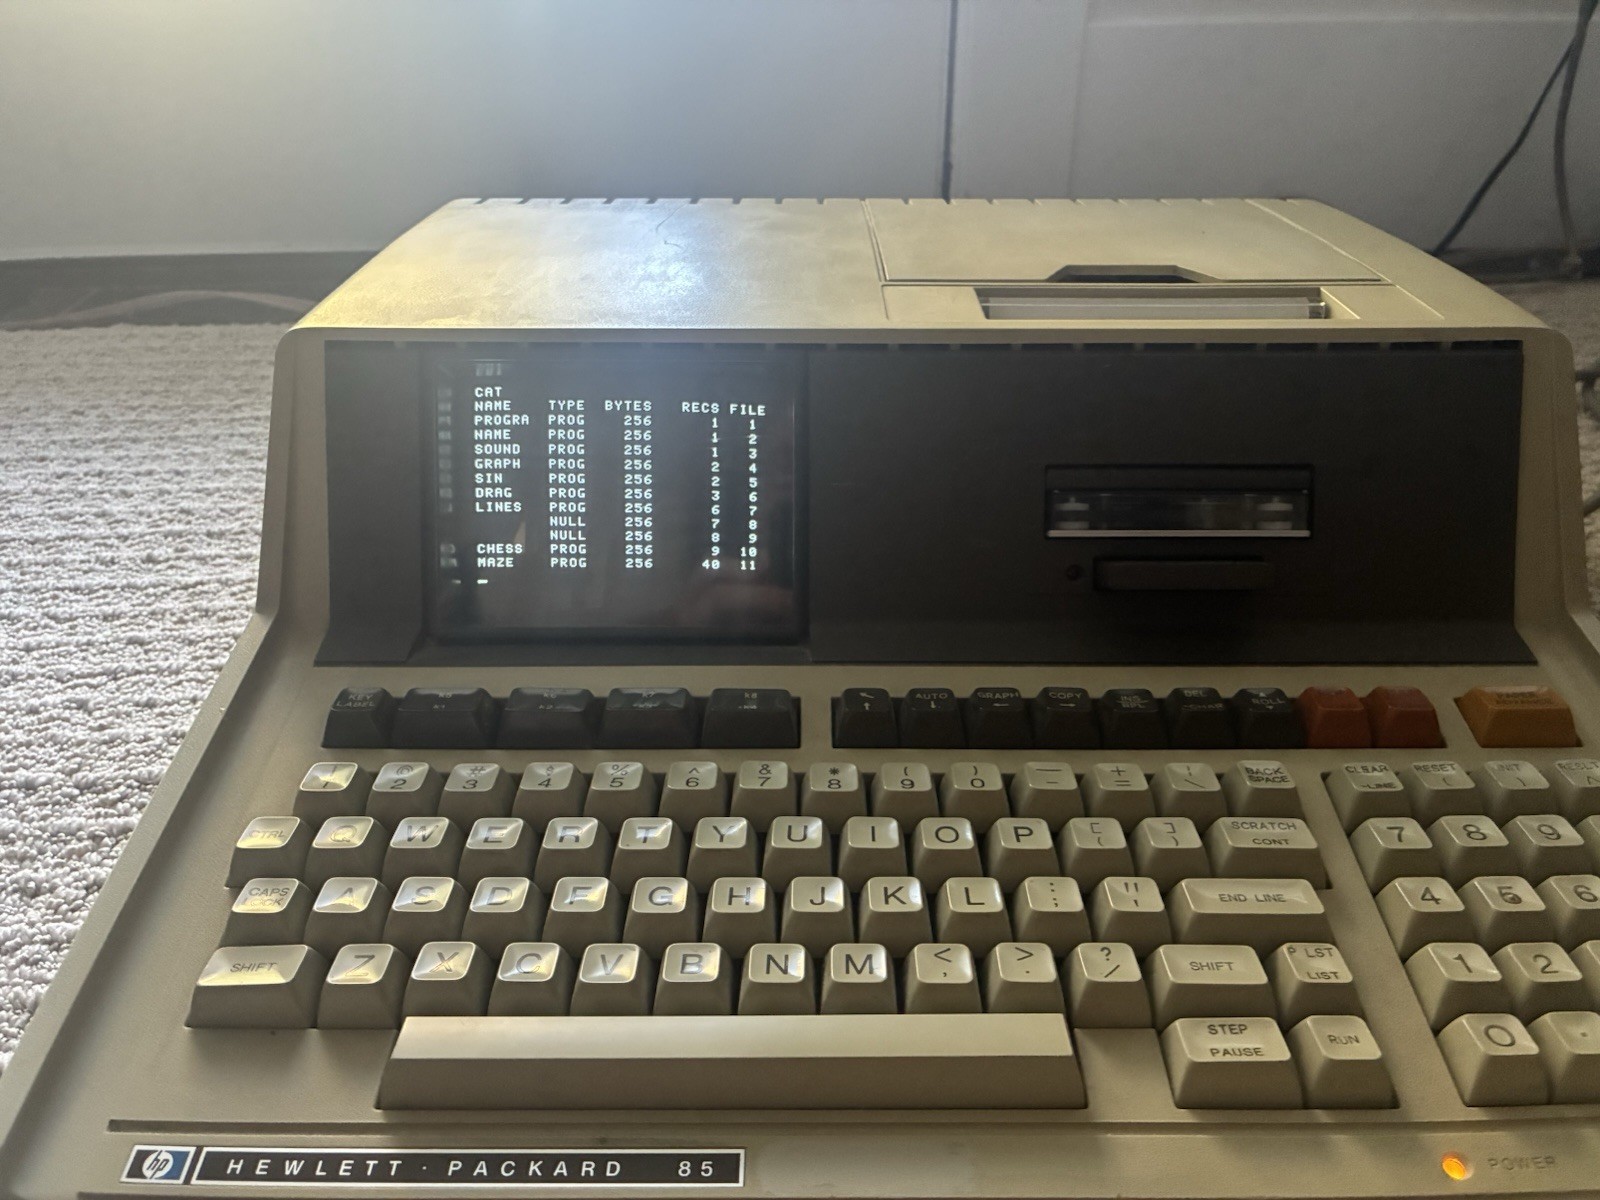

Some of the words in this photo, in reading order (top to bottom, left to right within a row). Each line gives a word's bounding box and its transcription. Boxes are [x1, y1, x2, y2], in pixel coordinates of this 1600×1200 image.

[474, 386, 503, 398] CAT
[474, 399, 512, 412] NAME
[548, 399, 585, 411] TYPE
[604, 399, 652, 412] BYTES
[681, 401, 720, 414] RECS
[729, 403, 766, 417] FILE
[473, 413, 530, 426] PROGRA
[548, 414, 585, 426] PROG
[623, 414, 652, 427] 256
[711, 416, 719, 429] 1
[749, 418, 756, 431] 1
[473, 428, 511, 441] NAME
[548, 428, 585, 440] PROG
[623, 429, 652, 442] 256
[711, 431, 720, 444] 1
[747, 433, 758, 445] 2
[474, 443, 521, 455] SOUND
[548, 443, 585, 455] PROG
[623, 444, 652, 456] 256
[711, 446, 719, 458] 1
[748, 447, 758, 460] 3
[474, 457, 521, 470] GRAPH
[548, 458, 586, 470] PROG
[623, 458, 653, 471] 256
[710, 460, 720, 473] 2
[748, 462, 758, 474] 4
[474, 472, 503, 484] SIN
[548, 472, 586, 484] PROG
[624, 473, 653, 486] 256
[710, 475, 721, 487] 2
[748, 476, 759, 489] 5
[474, 486, 513, 499] DRAG
[548, 487, 586, 499] PROG
[624, 488, 653, 500] 256
[711, 489, 721, 502] 3
[748, 491, 758, 503] 6
[475, 501, 522, 513] LINES
[549, 501, 586, 513] PROG
[624, 502, 653, 514] 256
[710, 504, 721, 516] 6
[748, 504, 758, 517] 7
[549, 515, 587, 527] NULL
[624, 516, 653, 528] 256
[711, 517, 721, 530] 7
[748, 518, 758, 531] 8
[549, 529, 587, 541] NULL
[624, 530, 653, 542] 256
[710, 531, 721, 543] 8
[748, 532, 758, 544] 9
[476, 542, 524, 555] CHESS
[549, 543, 587, 555] PROG
[624, 543, 654, 556] 256
[710, 545, 721, 557] 9
[740, 546, 758, 558] 10
[476, 556, 514, 568] MAZE
[550, 556, 587, 569] PROG
[625, 557, 654, 569] 256
[701, 558, 721, 570] 40
[740, 559, 757, 571] 11
[914, 692, 948, 700] AUTO
[1048, 692, 1083, 700] COPY
[1250, 697, 1286, 705] ROLL
[469, 766, 486, 777] #
[611, 763, 630, 776] %
[758, 763, 773, 775] &
[1244, 767, 1285, 775] BACK
[1345, 765, 1389, 774] CLEAR
[1412, 763, 1457, 772] RESET
[390, 779, 408, 789] 2
[462, 779, 478, 790] 3
[538, 777, 552, 788] 4
[610, 778, 624, 788] 5
[686, 778, 700, 788] 6
[758, 777, 771, 788] 7
[827, 778, 842, 790] 8
[900, 778, 915, 790] 9
[1248, 775, 1291, 783] SPACE
[249, 829, 285, 839] CTRL
[329, 824, 358, 843] Q
[406, 824, 440, 843] W
[483, 825, 508, 844] E
[558, 825, 583, 844] R
[637, 825, 659, 844] T
[712, 824, 735, 843] Y
[787, 824, 809, 843] U
[871, 825, 877, 843] I
[934, 825, 960, 844] O
[1013, 825, 1034, 844] P
[1231, 821, 1297, 831] SCRATCH
[1386, 825, 1405, 843] 7
[1462, 823, 1488, 841] 8
[1536, 823, 1562, 841] 9
[1252, 837, 1290, 846] CONT
[248, 887, 291, 897] CAPS
[334, 886, 355, 904] A
[411, 885, 436, 905] S
[486, 886, 513, 906] D
[565, 886, 593, 906] F
[648, 885, 673, 906] G
[727, 886, 751, 906] H
[809, 886, 826, 906] J
[883, 886, 907, 906] K
[964, 886, 985, 906] L
[1218, 893, 1247, 903] END
[1255, 893, 1286, 903] LINE
[1420, 886, 1441, 905] 4
[1497, 885, 1523, 905] 5
[1573, 885, 1599, 904] 6
[1099, 946, 1112, 962] ?
[1304, 947, 1334, 959] LST
[229, 962, 279, 973] SHIFT
[344, 954, 376, 977] Z
[428, 951, 459, 973] X
[516, 952, 542, 974] C
[600, 953, 624, 976] V
[680, 953, 703, 975] B
[765, 953, 789, 975] N
[845, 953, 874, 975] M
[1189, 961, 1235, 972] SHIFT
[1452, 953, 1474, 974] 1
[1532, 953, 1559, 975] 2
[1306, 971, 1340, 981] LIST
[1207, 1023, 1249, 1036] STEP
[1483, 1024, 1516, 1047] 0
[1326, 1033, 1361, 1047] RUN
[1209, 1047, 1265, 1058] PAUSE
[226, 1158, 403, 1176] HEWLETT
[447, 1160, 621, 1177] PACKARD
[677, 1160, 714, 1178] 85
